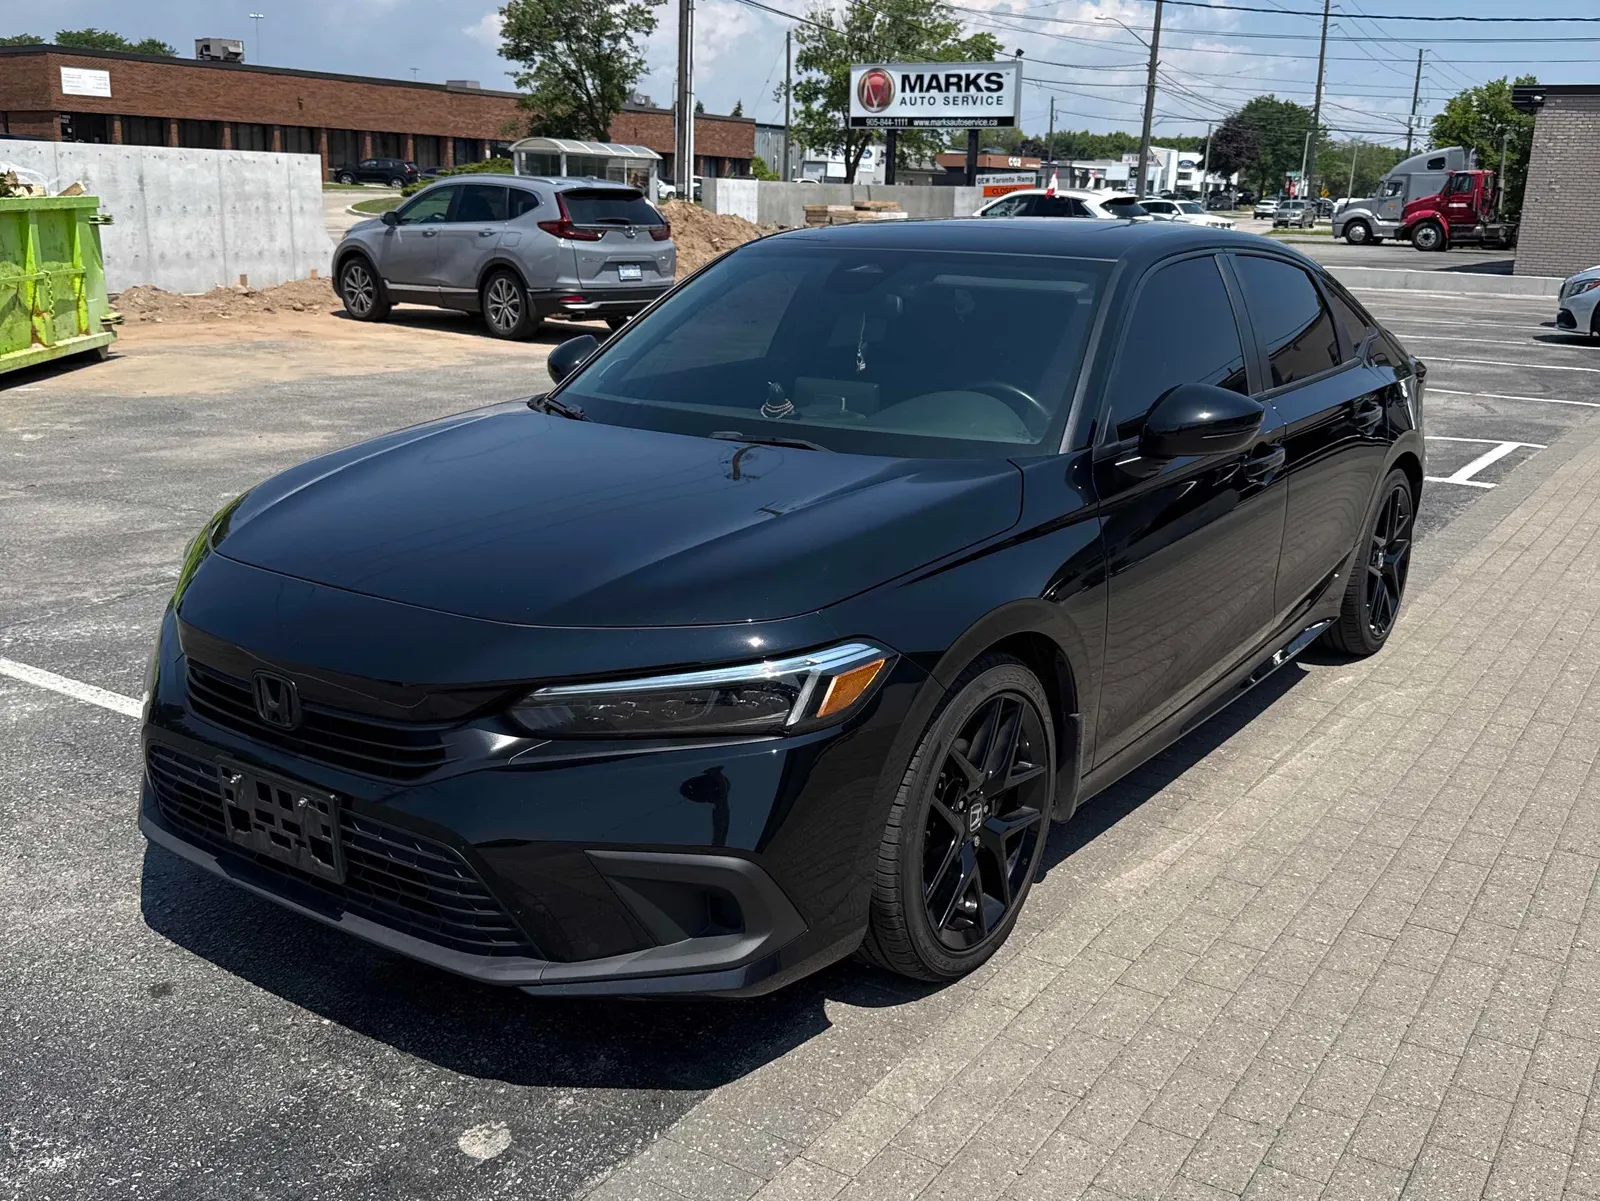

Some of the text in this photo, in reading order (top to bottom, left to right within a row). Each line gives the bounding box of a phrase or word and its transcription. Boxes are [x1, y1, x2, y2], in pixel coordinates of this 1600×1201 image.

[901, 72, 1004, 93] MARKS
[900, 95, 1004, 106] AUTO SERVICE
[866, 118, 998, 127] 905-844-1111 www.marksautoservice.ca
